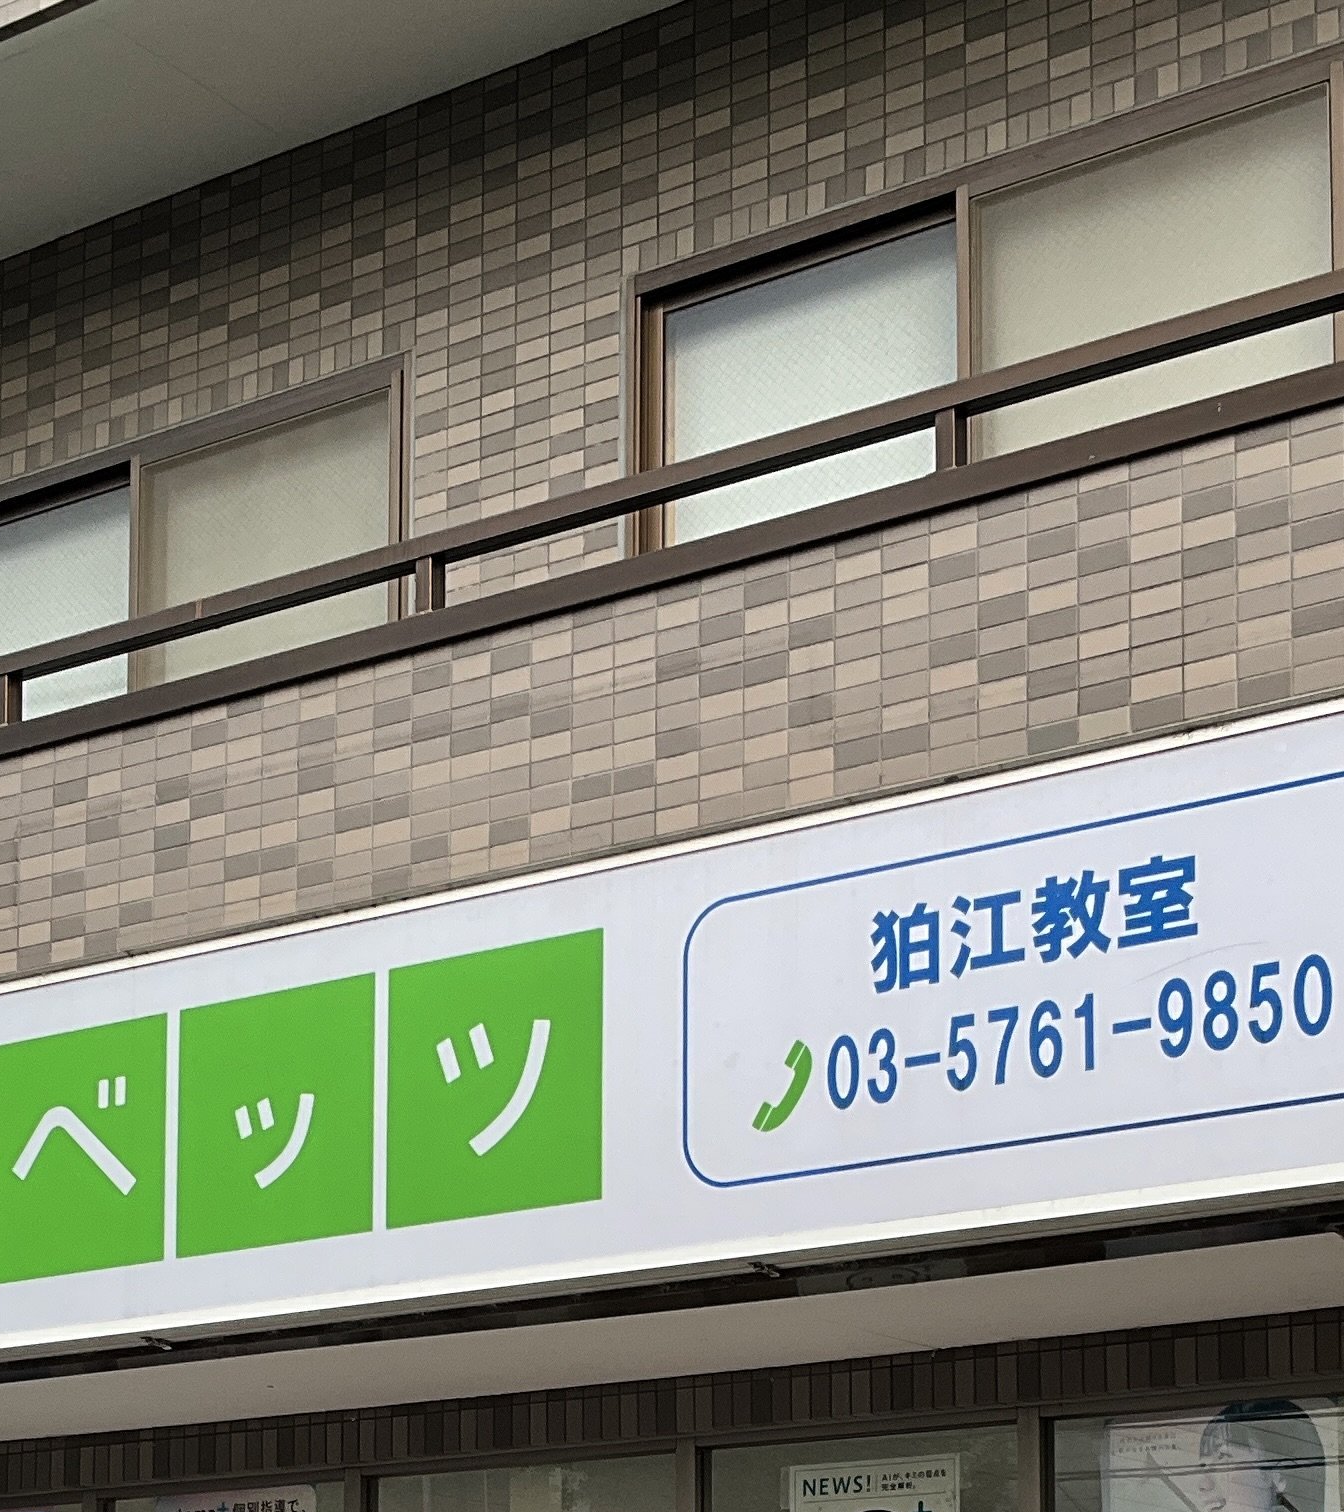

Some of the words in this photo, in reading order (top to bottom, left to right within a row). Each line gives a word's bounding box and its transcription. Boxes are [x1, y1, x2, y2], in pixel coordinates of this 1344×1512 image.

[869, 854, 1200, 994] 狛江教室
[826, 953, 1334, 1110] 03-5761-9850
[801, 1474, 872, 1498] NEWS!
